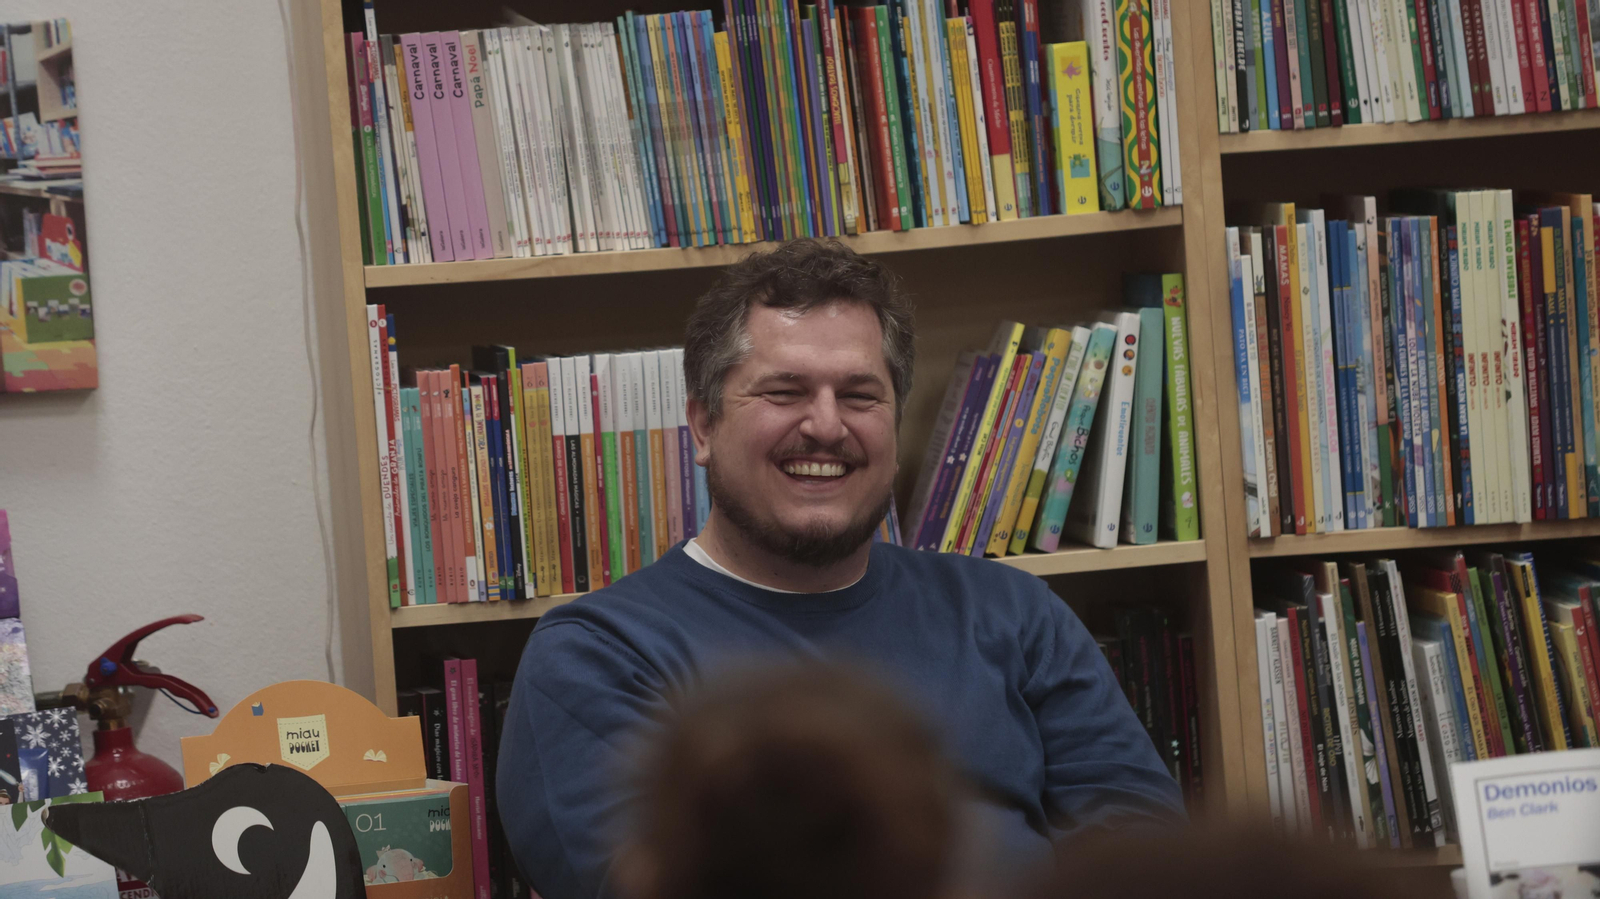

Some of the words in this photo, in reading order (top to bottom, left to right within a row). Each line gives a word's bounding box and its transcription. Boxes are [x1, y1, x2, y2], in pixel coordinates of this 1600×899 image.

[1235, 0, 1244, 30] MBRA
[1133, 27, 1141, 39] Las
[1262, 10, 1273, 45] AZUL
[465, 44, 478, 73] Noel
[1134, 40, 1144, 73] divertidas
[1236, 30, 1246, 71] REBELDE
[407, 44, 424, 100] Carnaval
[426, 43, 444, 100] Carnaval
[445, 42, 463, 99] Carnaval
[469, 76, 485, 108] Papá
[1136, 74, 1145, 108] aventuras
[1066, 94, 1074, 114] para
[1139, 109, 1146, 119] de
[1069, 114, 1078, 143] dormir
[1139, 119, 1147, 129] las
[1140, 130, 1148, 151] letras
[1287, 213, 1295, 244] Marianne
[1504, 219, 1512, 229] EL
[1504, 231, 1513, 253] HILO
[1279, 244, 1290, 286] MAMAS
[1488, 246, 1496, 270] TIRADO
[1506, 255, 1516, 299] INVISIBLE
[1283, 296, 1291, 320] Nancy
[1170, 316, 1185, 361] NUEVAS
[1238, 329, 1246, 350] PATO
[1398, 334, 1407, 347] LOS
[1408, 337, 1417, 358] LOLA
[1446, 333, 1452, 341] el
[1448, 342, 1454, 352] en
[1240, 352, 1247, 363] VA
[1399, 348, 1408, 377] COLORES
[1418, 350, 1426, 358] EL
[1511, 351, 1520, 378] TIRADO
[1241, 363, 1248, 376] EN
[1411, 368, 1418, 378] LA
[1467, 353, 1477, 387] INFINITO
[1480, 352, 1490, 387] INFINITO
[1493, 351, 1503, 386] INFINITO
[1174, 364, 1189, 412] FÁBULAS
[1260, 364, 1270, 401] NUEVO
[1401, 378, 1409, 388] DE
[1402, 388, 1409, 398] LA
[1420, 388, 1428, 398] DE
[1448, 380, 1456, 395] Una
[1457, 372, 1466, 403] NEVADA
[1421, 399, 1428, 409] LA
[1458, 403, 1467, 425] GRAN
[1116, 401, 1130, 457] Emoticuentos
[1177, 415, 1187, 429] DE
[1413, 404, 1421, 437] VIOLETA
[1460, 427, 1468, 436] LA
[1068, 425, 1089, 466] Bichos
[1266, 438, 1275, 471] Lauren
[388, 439, 398, 475] GRANJA
[606, 455, 611, 463] DE
[1178, 430, 1192, 486] ANIMALES
[381, 455, 392, 500] DUENDES
[557, 467, 563, 476] UN
[606, 464, 612, 472] UN
[392, 475, 399, 485] de
[409, 473, 417, 506] ESPECIALES
[450, 466, 458, 492] canguro
[1268, 473, 1278, 498] Child
[385, 501, 392, 512] de
[393, 486, 401, 517] Animales
[454, 511, 460, 519] La
[449, 687, 458, 700] gran
[450, 679, 458, 687] El
[451, 701, 460, 716] libro
[453, 715, 460, 723] de
[1322, 707, 1334, 736] RICITOS
[286, 727, 320, 740] miau
[452, 724, 461, 750] misterios
[1326, 738, 1335, 748] DE
[289, 739, 320, 755] POCKET
[454, 750, 462, 758] de
[1317, 743, 1324, 751] El
[1318, 751, 1326, 767] viaje
[1328, 749, 1337, 767] OSO
[454, 759, 463, 780] Isadora
[1320, 767, 1327, 777] de
[1484, 775, 1598, 802] Demonios
[355, 812, 387, 833] 01
